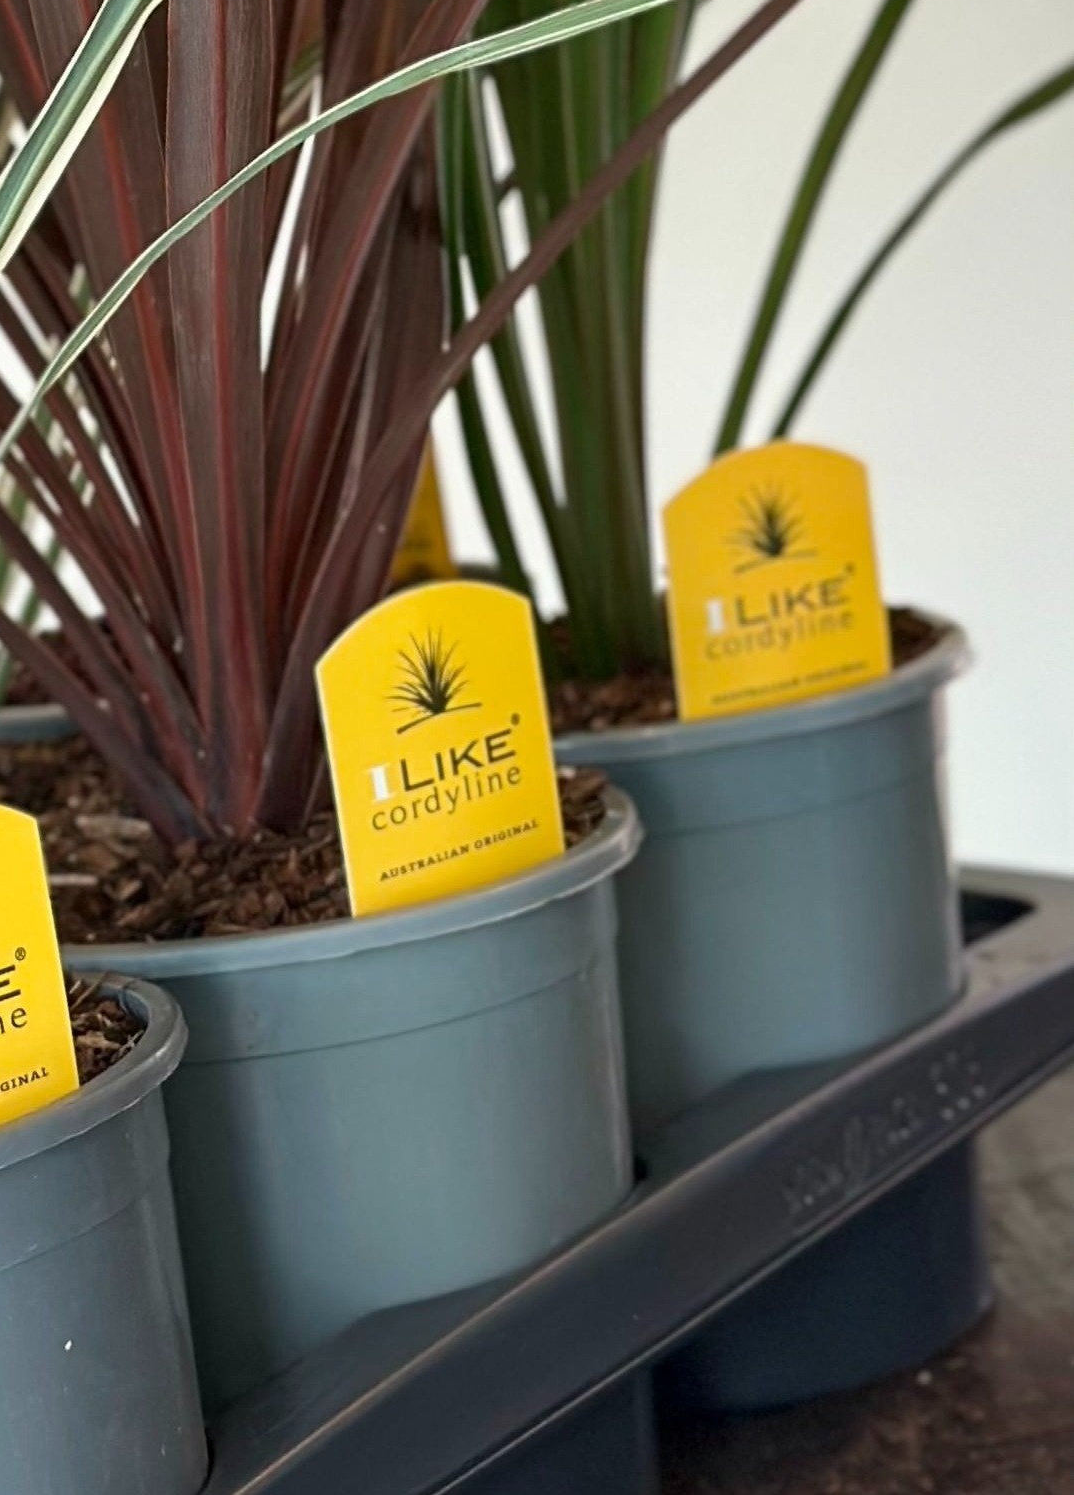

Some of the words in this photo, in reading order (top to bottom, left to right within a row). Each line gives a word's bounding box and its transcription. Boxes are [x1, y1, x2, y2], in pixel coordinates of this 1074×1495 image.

[705, 610, 854, 661] cordyline
[364, 763, 398, 803] I
[372, 766, 522, 830] cordyline
[380, 843, 470, 881] AUSTRALIAN
[474, 819, 539, 849] ORIGINAL
